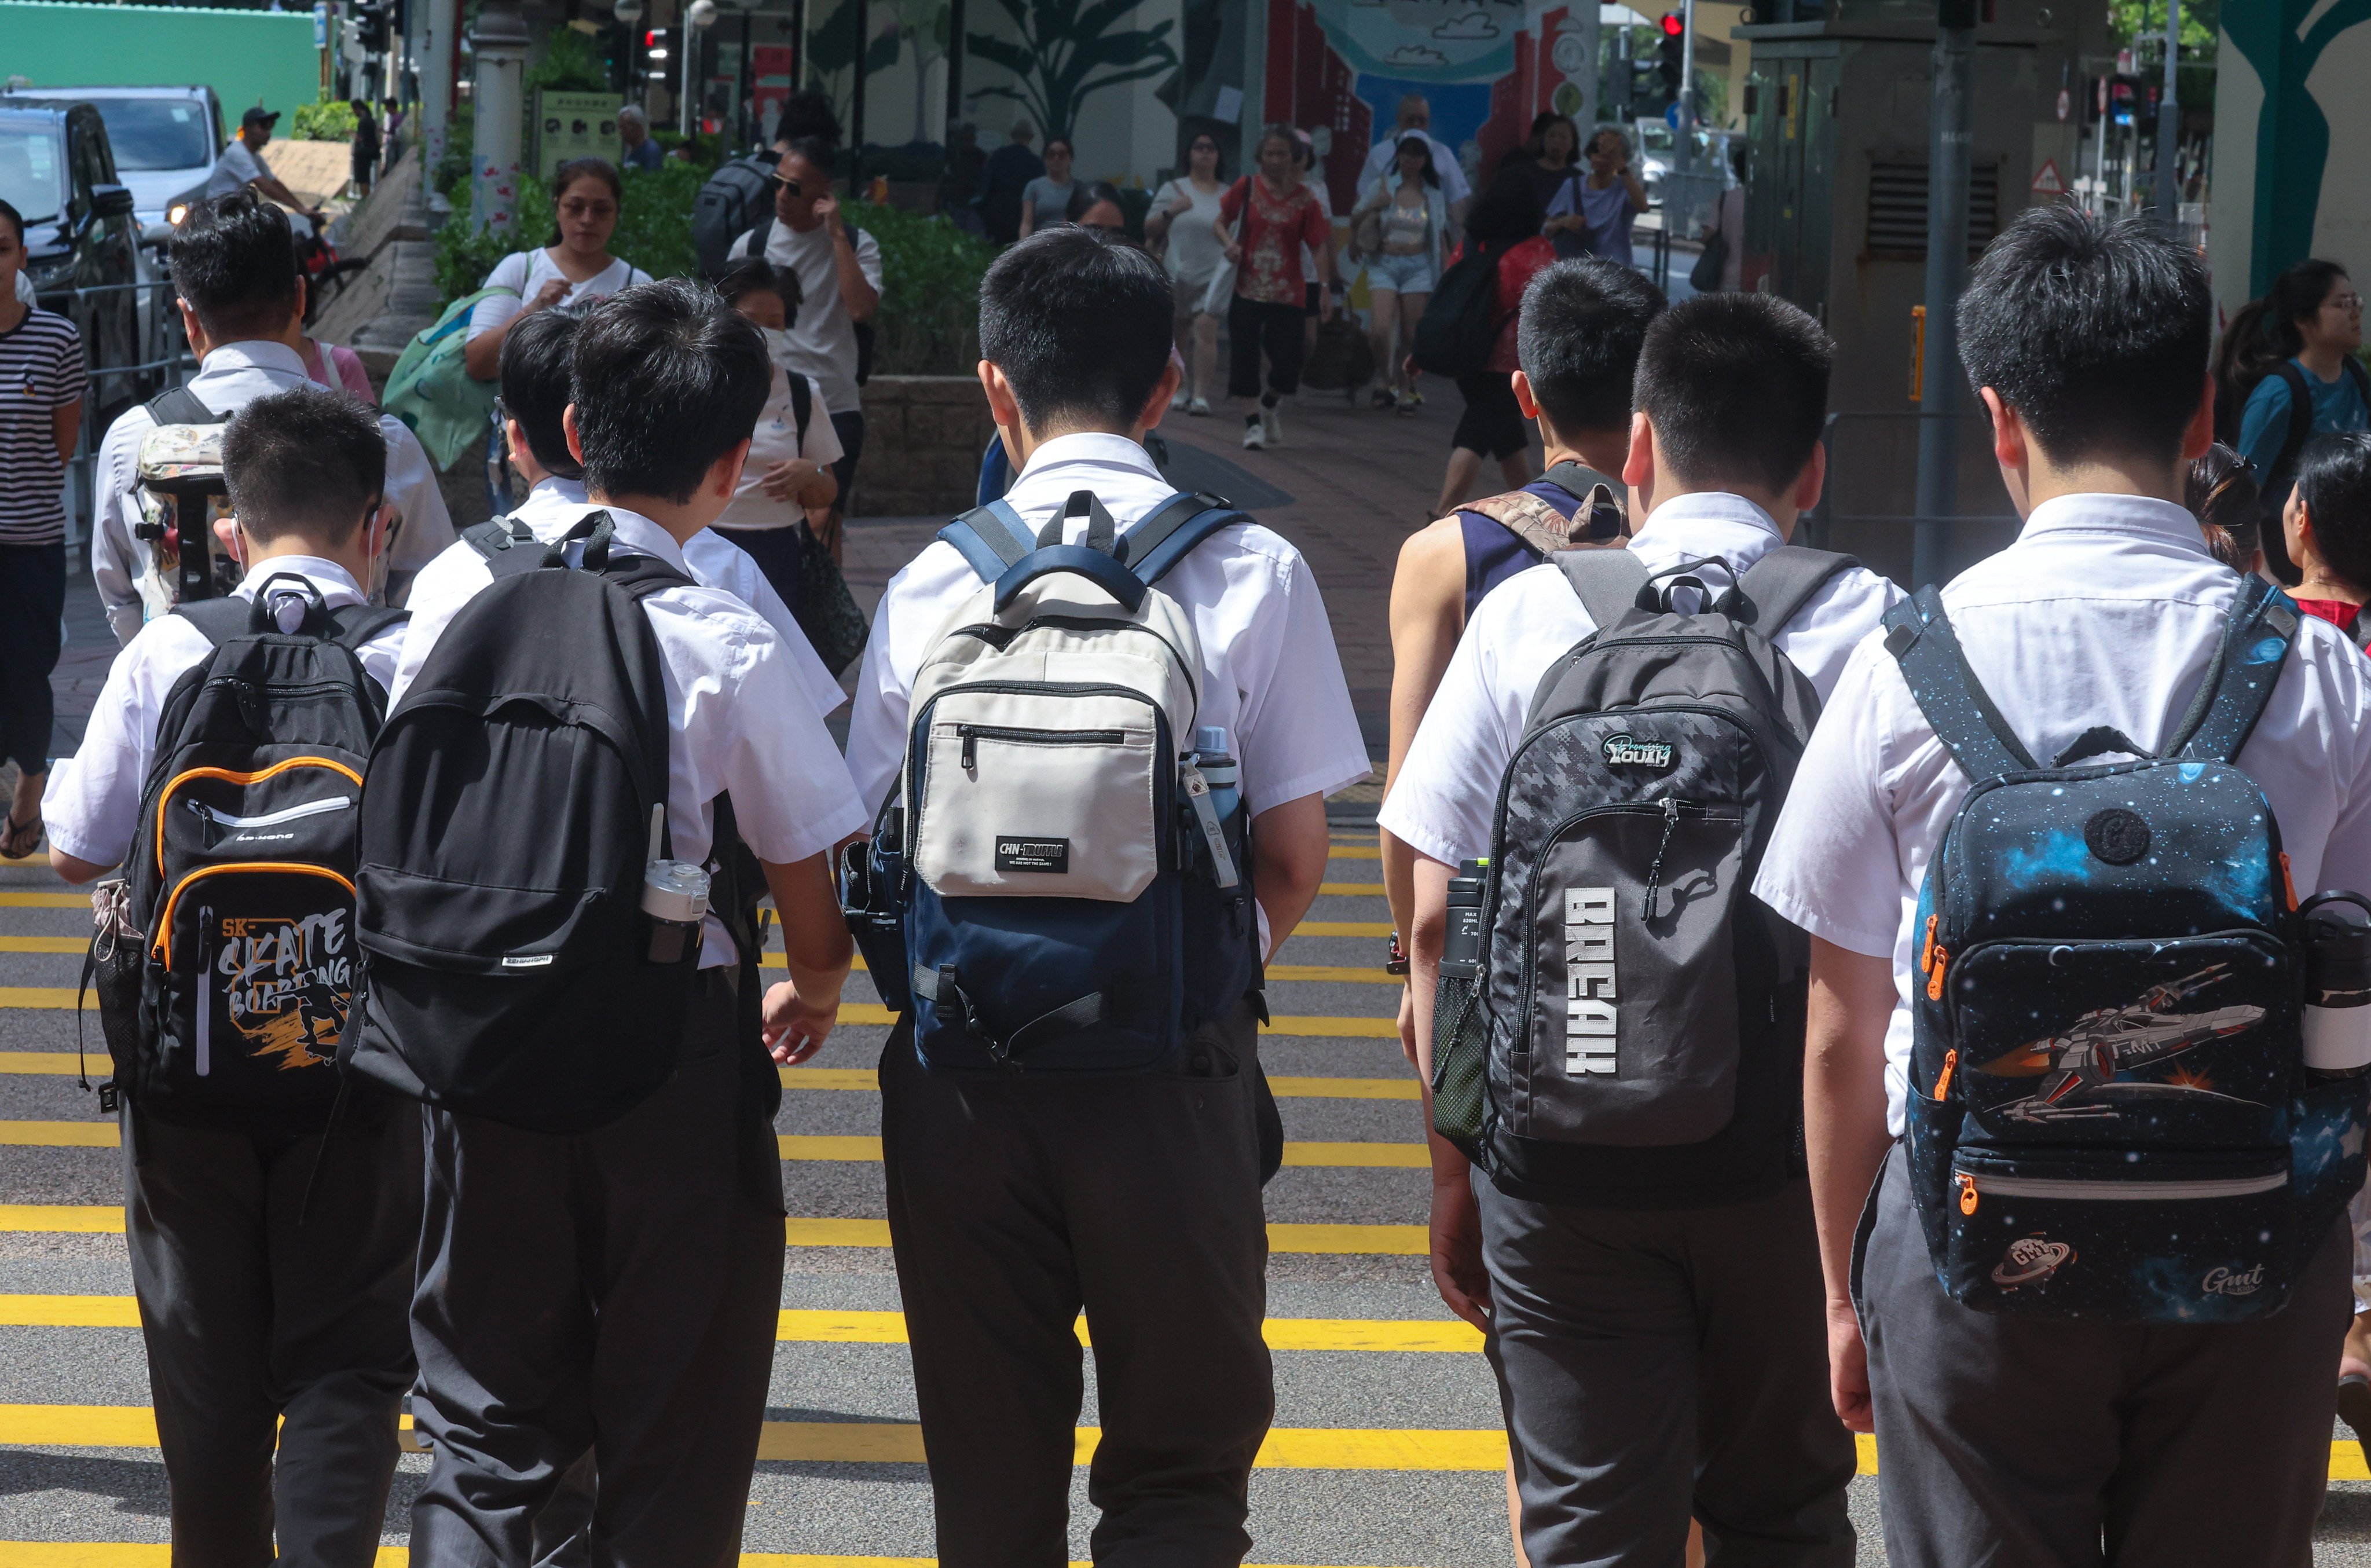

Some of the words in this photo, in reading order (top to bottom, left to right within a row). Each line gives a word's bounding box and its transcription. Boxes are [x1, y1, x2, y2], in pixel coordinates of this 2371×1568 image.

[999, 843, 1063, 857] CHN-TRUFFLE
[218, 908, 346, 994] SKATE
[2012, 1240, 2050, 1266] GMT
[2202, 1263, 2265, 1295] Gmt
